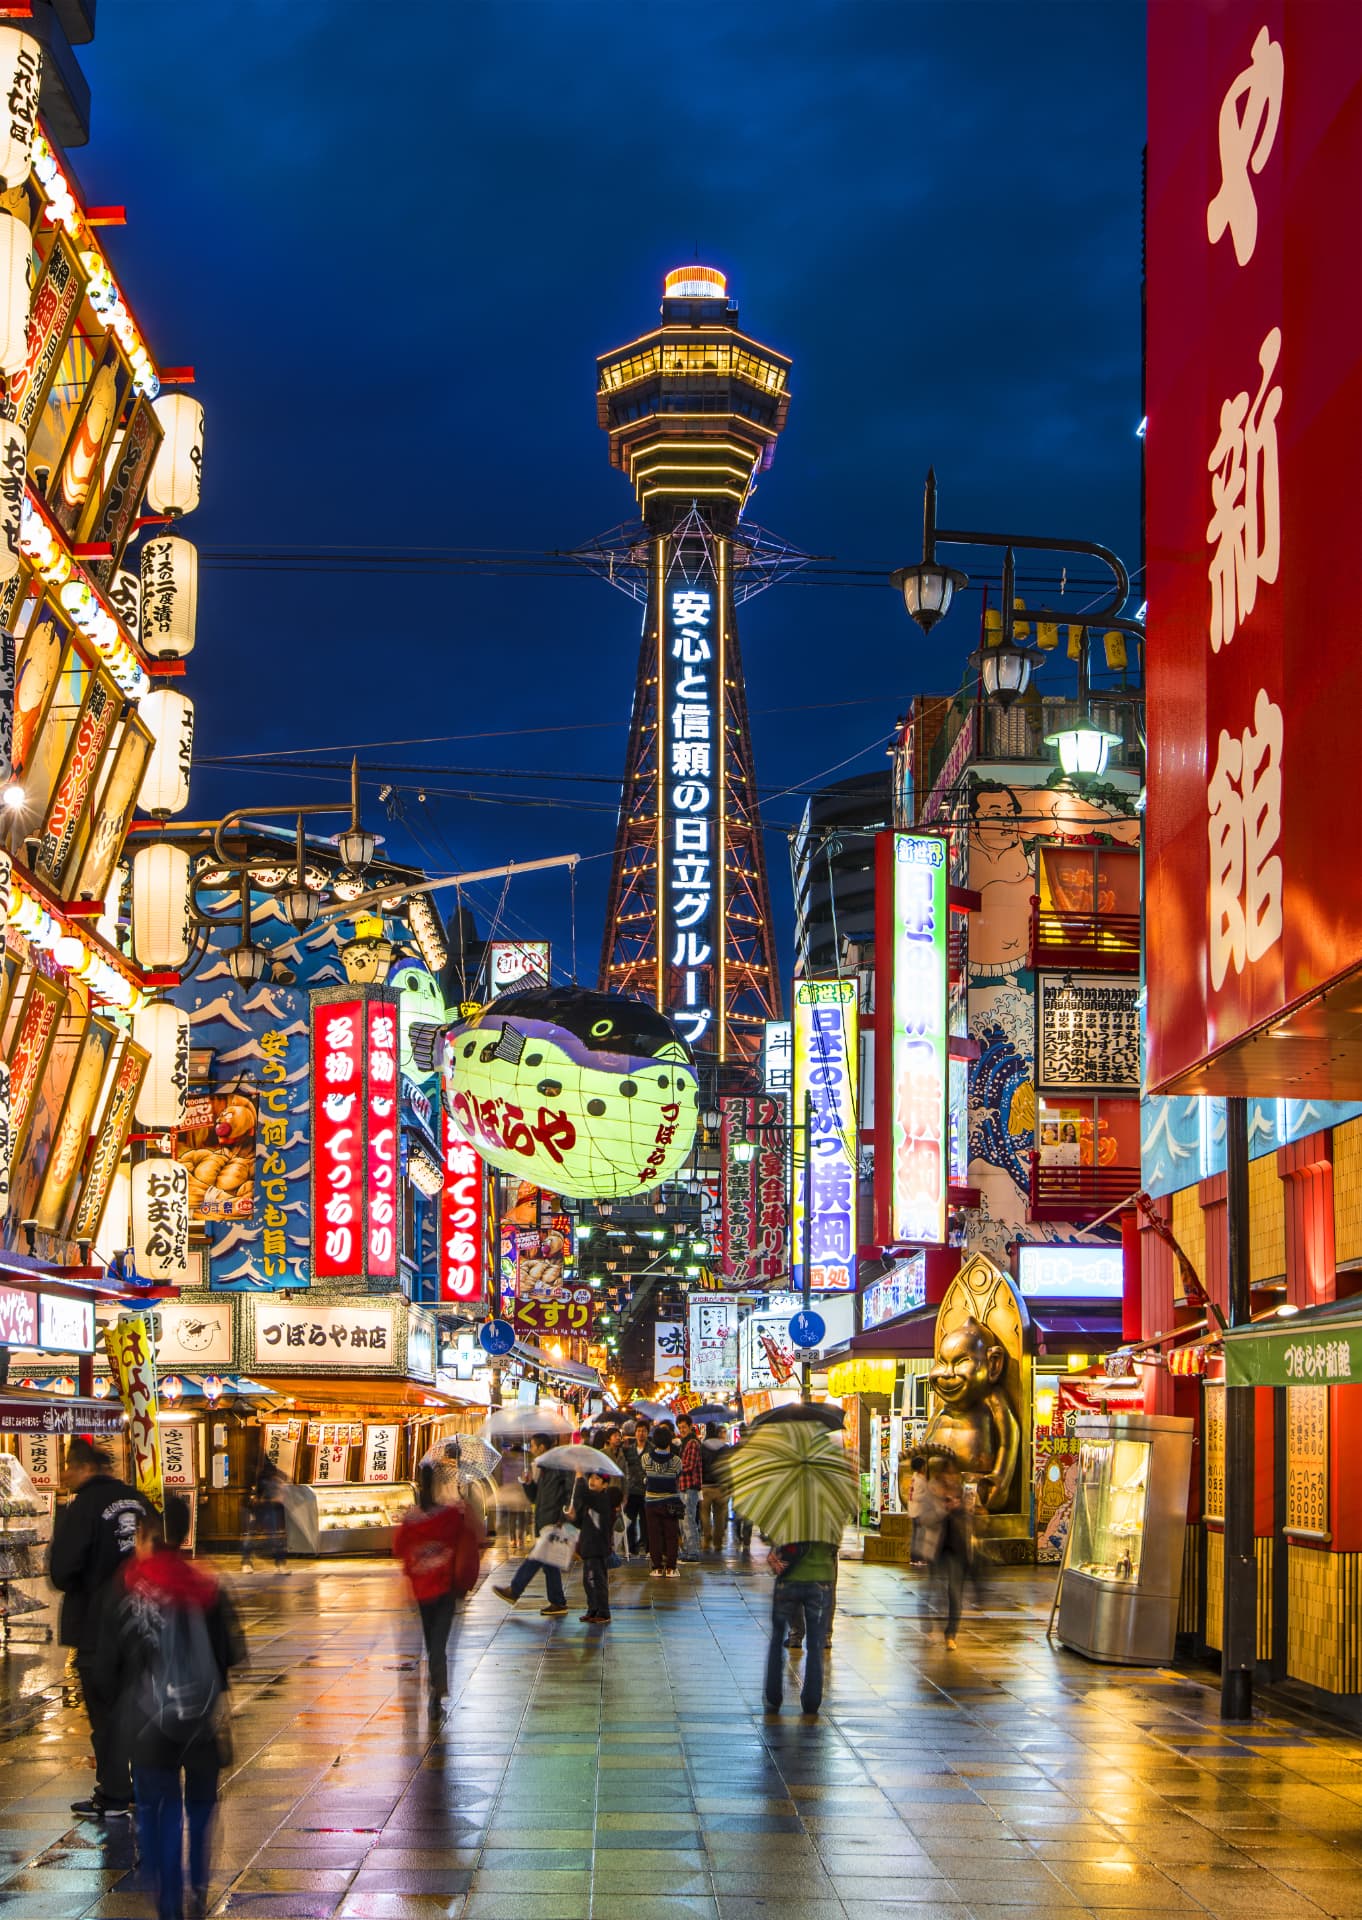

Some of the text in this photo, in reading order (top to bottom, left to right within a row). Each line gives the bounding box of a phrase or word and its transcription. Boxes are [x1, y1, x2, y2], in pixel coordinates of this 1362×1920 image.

[153, 541, 178, 632] ソースの二度漬け
[672, 590, 711, 1043] 安心と信頼の日立グループ
[897, 837, 944, 868] 新世界
[799, 983, 854, 1004] 新世界
[259, 1030, 289, 1276] 安うて何んでも旨い
[452, 1089, 576, 1164] づぼらや
[638, 1101, 684, 1183] づぼらや
[324, 1129, 352, 1264] てっちり
[370, 1132, 394, 1263] てっちり
[725, 1099, 750, 1281] 広々とお座敷もあります!!
[262, 1322, 387, 1349] づぼらや本店
[517, 1301, 588, 1328] くすり
[795, 1352, 818, 1360] 9-22
